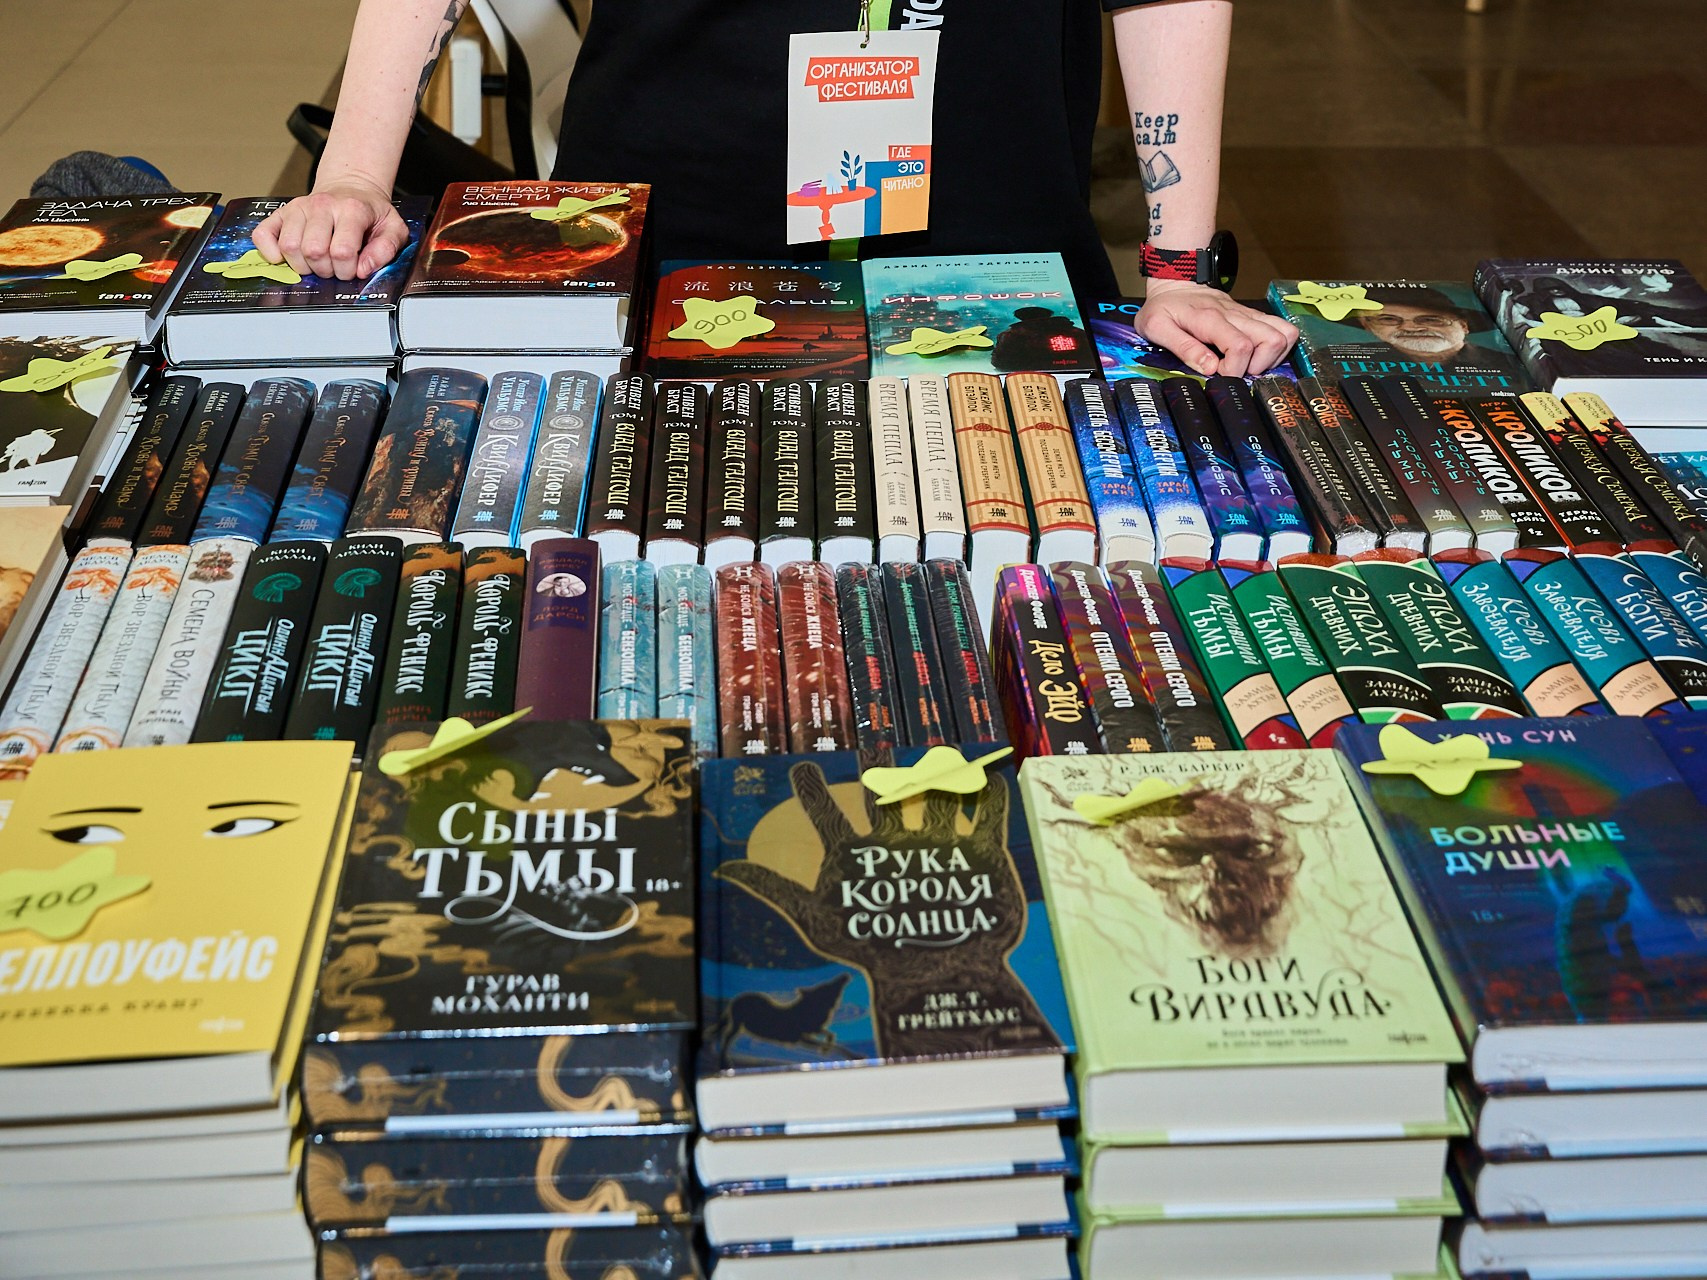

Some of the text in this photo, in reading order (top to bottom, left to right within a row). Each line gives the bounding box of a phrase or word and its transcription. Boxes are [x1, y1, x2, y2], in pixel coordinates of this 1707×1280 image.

[810, 60, 914, 79] ОРГАНИЗАТОР
[821, 79, 908, 100] ФЕСТИВАЛЯ
[1134, 111, 1179, 132] Keep
[1135, 129, 1176, 146] calm
[891, 147, 911, 159] ГДЕ
[898, 161, 924, 173] ЭТО
[462, 193, 551, 201] СМЕРТИ
[465, 186, 548, 194] ВЕЧНАЯ
[884, 177, 924, 192] ЧИТАНО
[36, 209, 77, 217] ТЕЛ
[40, 197, 198, 210] ЗАДАЧА ТРЕХ
[562, 280, 616, 288] fanzon
[1556, 267, 1615, 275] ДЖИН
[98, 293, 153, 302] fanzon
[335, 293, 388, 301] fanzon
[693, 309, 747, 335] 900
[1554, 319, 1607, 341] 300
[1333, 361, 1444, 373] ТЕРРИ
[613, 379, 629, 405] БРАСТ
[628, 376, 644, 410] СТИВЕН
[666, 388, 681, 415] БРАСТ
[681, 385, 696, 419] СТИВЕН
[722, 385, 736, 412] БРАСТ
[736, 382, 751, 417] СТИВЕН
[772, 386, 787, 413] БРАСТ
[788, 382, 802, 417] СТИВЕН
[826, 386, 841, 413] БРАСТ
[841, 382, 856, 417] СТИВЕН
[964, 385, 979, 413] БЛЭЙЛОК
[977, 385, 992, 414] ДЖЕЙМС
[1022, 384, 1036, 413] БЛЭЙЛОК
[1036, 385, 1053, 413] ДЖЕЙМС
[609, 422, 636, 454] ВЛАД
[879, 383, 903, 466] ВРЕМЯ ПЕПЛА
[919, 379, 946, 463] ВРЕМЯ ПЕПЛА
[1081, 384, 1125, 479] ПОХИТИТЕЛЬ БЕССМЕРТИЯ
[1130, 383, 1179, 478] ПОХИТИТЕЛЬ БЕССМЕРТИЯ
[664, 431, 690, 463] ВЛАД
[721, 428, 746, 460] ВЛАД
[773, 430, 799, 461] ВЛАД
[830, 430, 855, 461] ВЛАД
[1439, 408, 1529, 505] КРОЛИКОВ
[1487, 409, 1582, 504] КРОЛИКОВ
[1310, 440, 1352, 502] ОППЕНГЕЙМЕР
[1354, 440, 1397, 501] ОППЕНГЕЙМЕР
[1387, 442, 1421, 485] ТЬМЫ
[1395, 428, 1441, 496] СКОРОСТЬ
[1429, 441, 1465, 485] ТЬМЫ
[1437, 428, 1486, 496] СКОРОСТЬ
[68, 595, 91, 619] ВОР
[130, 595, 153, 618] ВОР
[171, 588, 216, 647] СЕМЕНА
[1331, 585, 1400, 658] ЭПОХА
[1386, 592, 1443, 653] ДРЕВНИХ
[1408, 582, 1480, 654] ЭПОХА
[1461, 582, 1533, 663] ЗАВОЕВАТЕЛЯ
[1497, 596, 1550, 646] КРОВЬ
[1534, 580, 1609, 662] ЗАВОЕВАТЕЛЯ
[1571, 595, 1626, 645] КРОВЬ
[1616, 592, 1669, 642] БОГИ
[1622, 573, 1703, 649] СТАЛЬНЫЕ
[741, 617, 757, 652] ЖНЕЦА
[806, 614, 823, 649] ЖНЕЦА
[1189, 608, 1235, 659] ТЬМЫ
[1206, 593, 1262, 666] ИСПИВШИЙ
[1249, 608, 1296, 661] ТЬМЫ
[1265, 593, 1325, 668] ИСПИВШИЙ
[1308, 596, 1363, 657] ДРЕВНИХ
[158, 648, 195, 702] ВОЙНЫ
[219, 623, 270, 710] ЦИКЛ
[254, 618, 296, 714] ОДИННАДЦАТЫЙ
[308, 621, 352, 706] ЦИКЛ
[343, 612, 378, 707] ОДИННАДЦАТЫЙ
[620, 630, 636, 686] БЕНЗОПИЛА
[678, 634, 694, 691] БЕНЗОПИЛА
[1089, 631, 1135, 708] ОТТЕНКИ СЕРОГО
[1149, 631, 1197, 708] ОТТЕНКИ СЕРОГО
[1364, 680, 1429, 700] ЗАМИЛЬ
[1368, 689, 1420, 702] АХТАР
[1446, 675, 1512, 697] ЗАМИЛЬ
[1451, 684, 1503, 698] АХТАР
[1437, 729, 1577, 745] ХНЬ СУН
[1119, 763, 1133, 774] Р.
[1178, 761, 1246, 774] БАРКЕР
[437, 800, 619, 845] СЫНЫ
[1429, 821, 1626, 847] БОЛЬНЫЕ
[851, 846, 971, 878] РУКА
[1445, 848, 1572, 876] ДУШИ
[412, 847, 639, 916] ТЬМЫ
[841, 873, 994, 911] КОРОЛЯ
[847, 907, 998, 946] СОЛНЦА
[465, 973, 560, 993] ГУРАВ
[1187, 953, 1305, 985] БОГИ
[431, 992, 590, 1015] МОХАНТИ
[1130, 967, 1392, 1023] ВИРДВУДА
[898, 1007, 1021, 1031] ГРЕЙТХАУС
